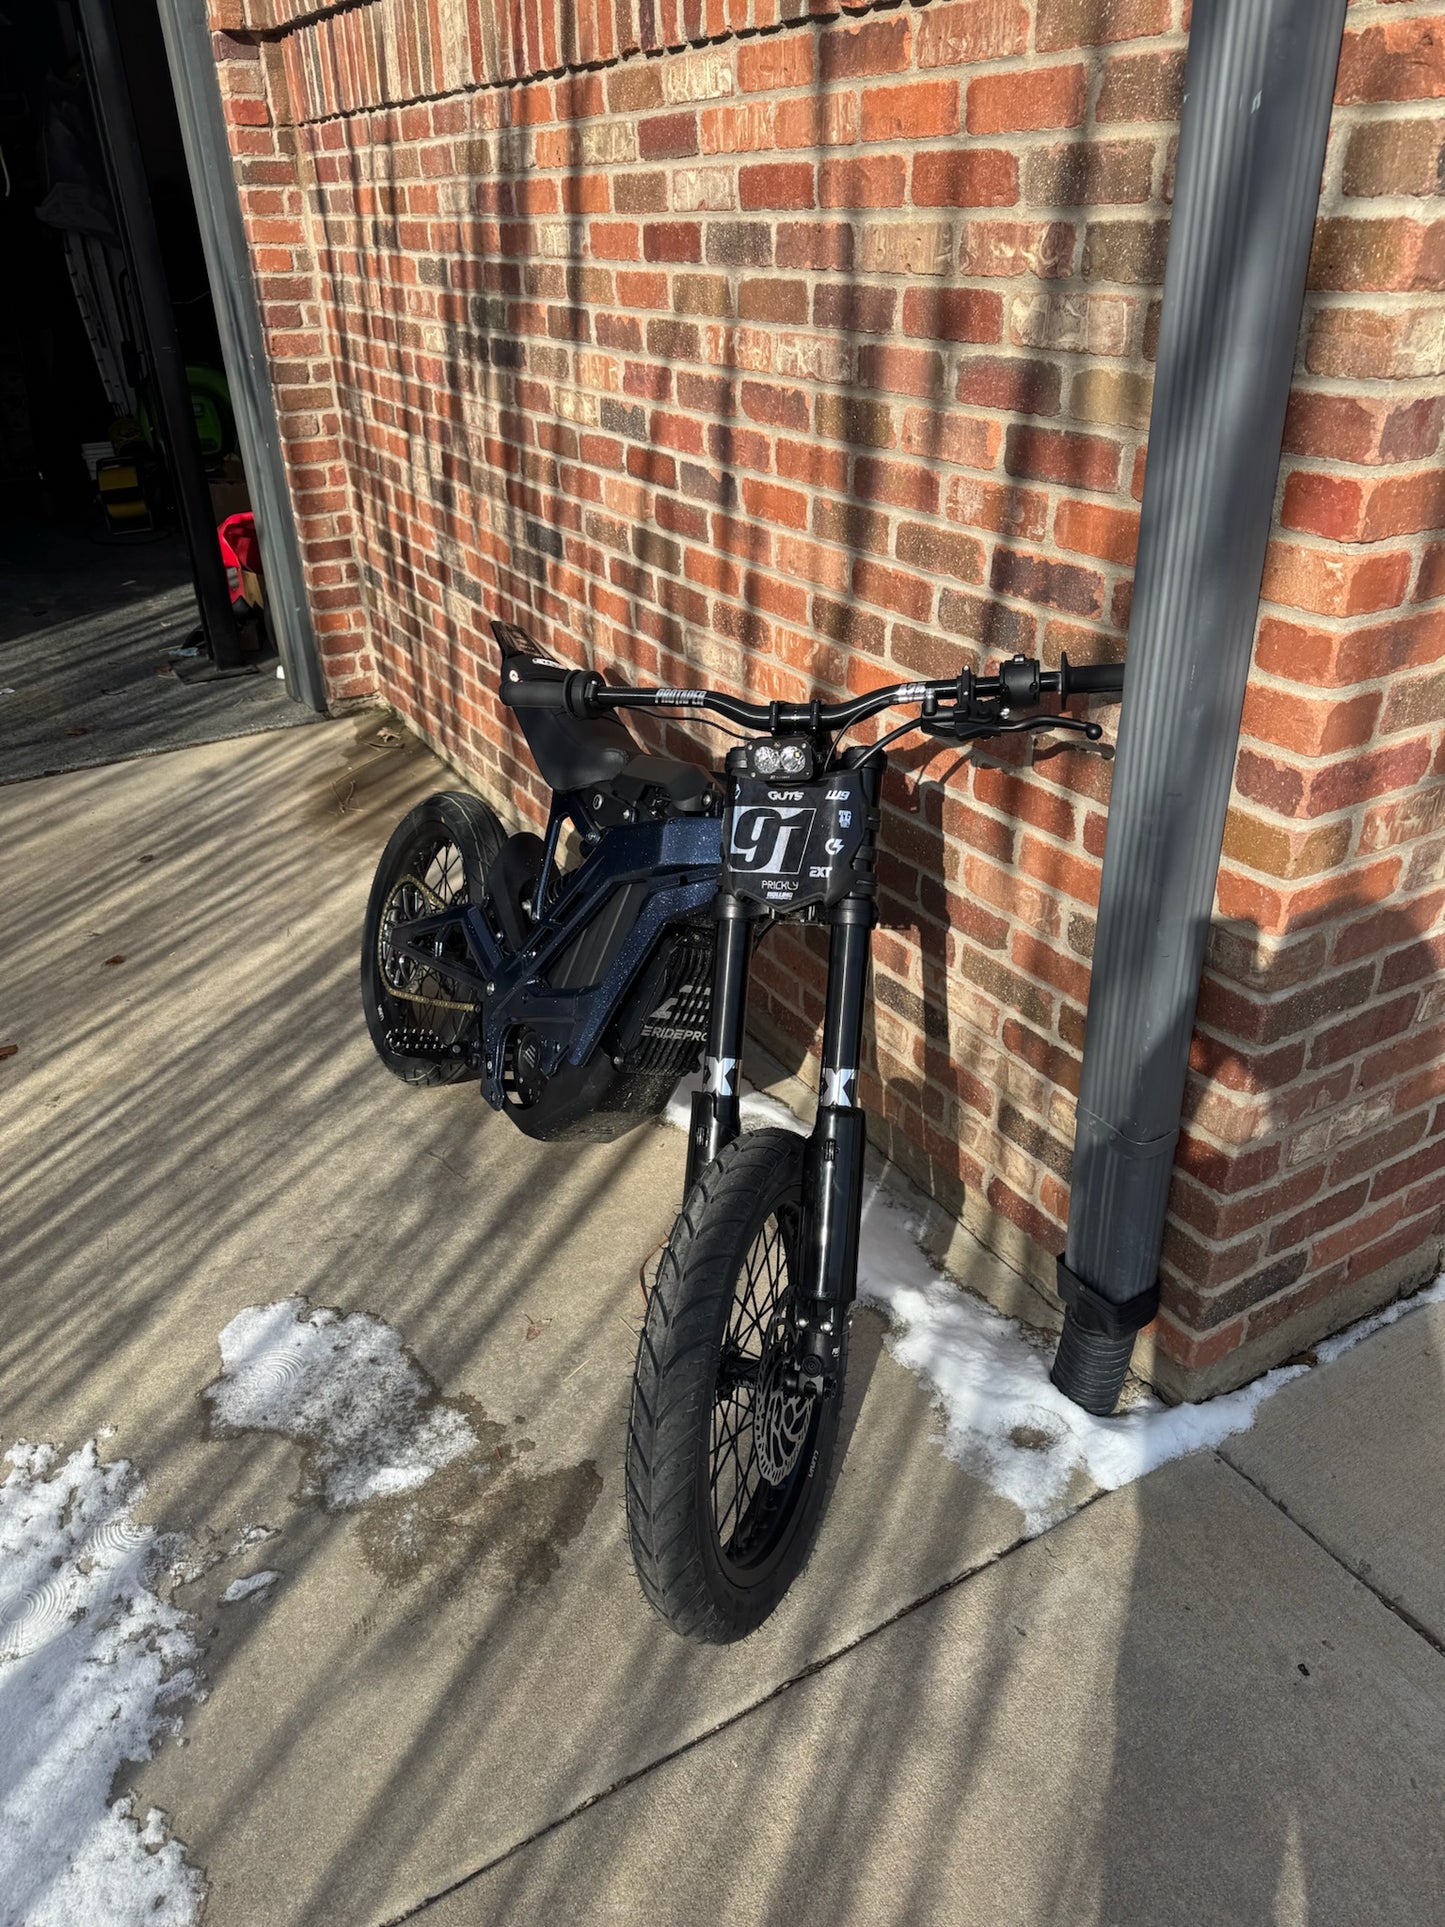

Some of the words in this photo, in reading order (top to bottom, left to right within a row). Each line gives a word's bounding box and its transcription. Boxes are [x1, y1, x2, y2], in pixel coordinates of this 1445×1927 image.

[767, 790, 804, 801] GUTS
[730, 808, 814, 872] 91
[761, 880, 799, 891] PRICKLY
